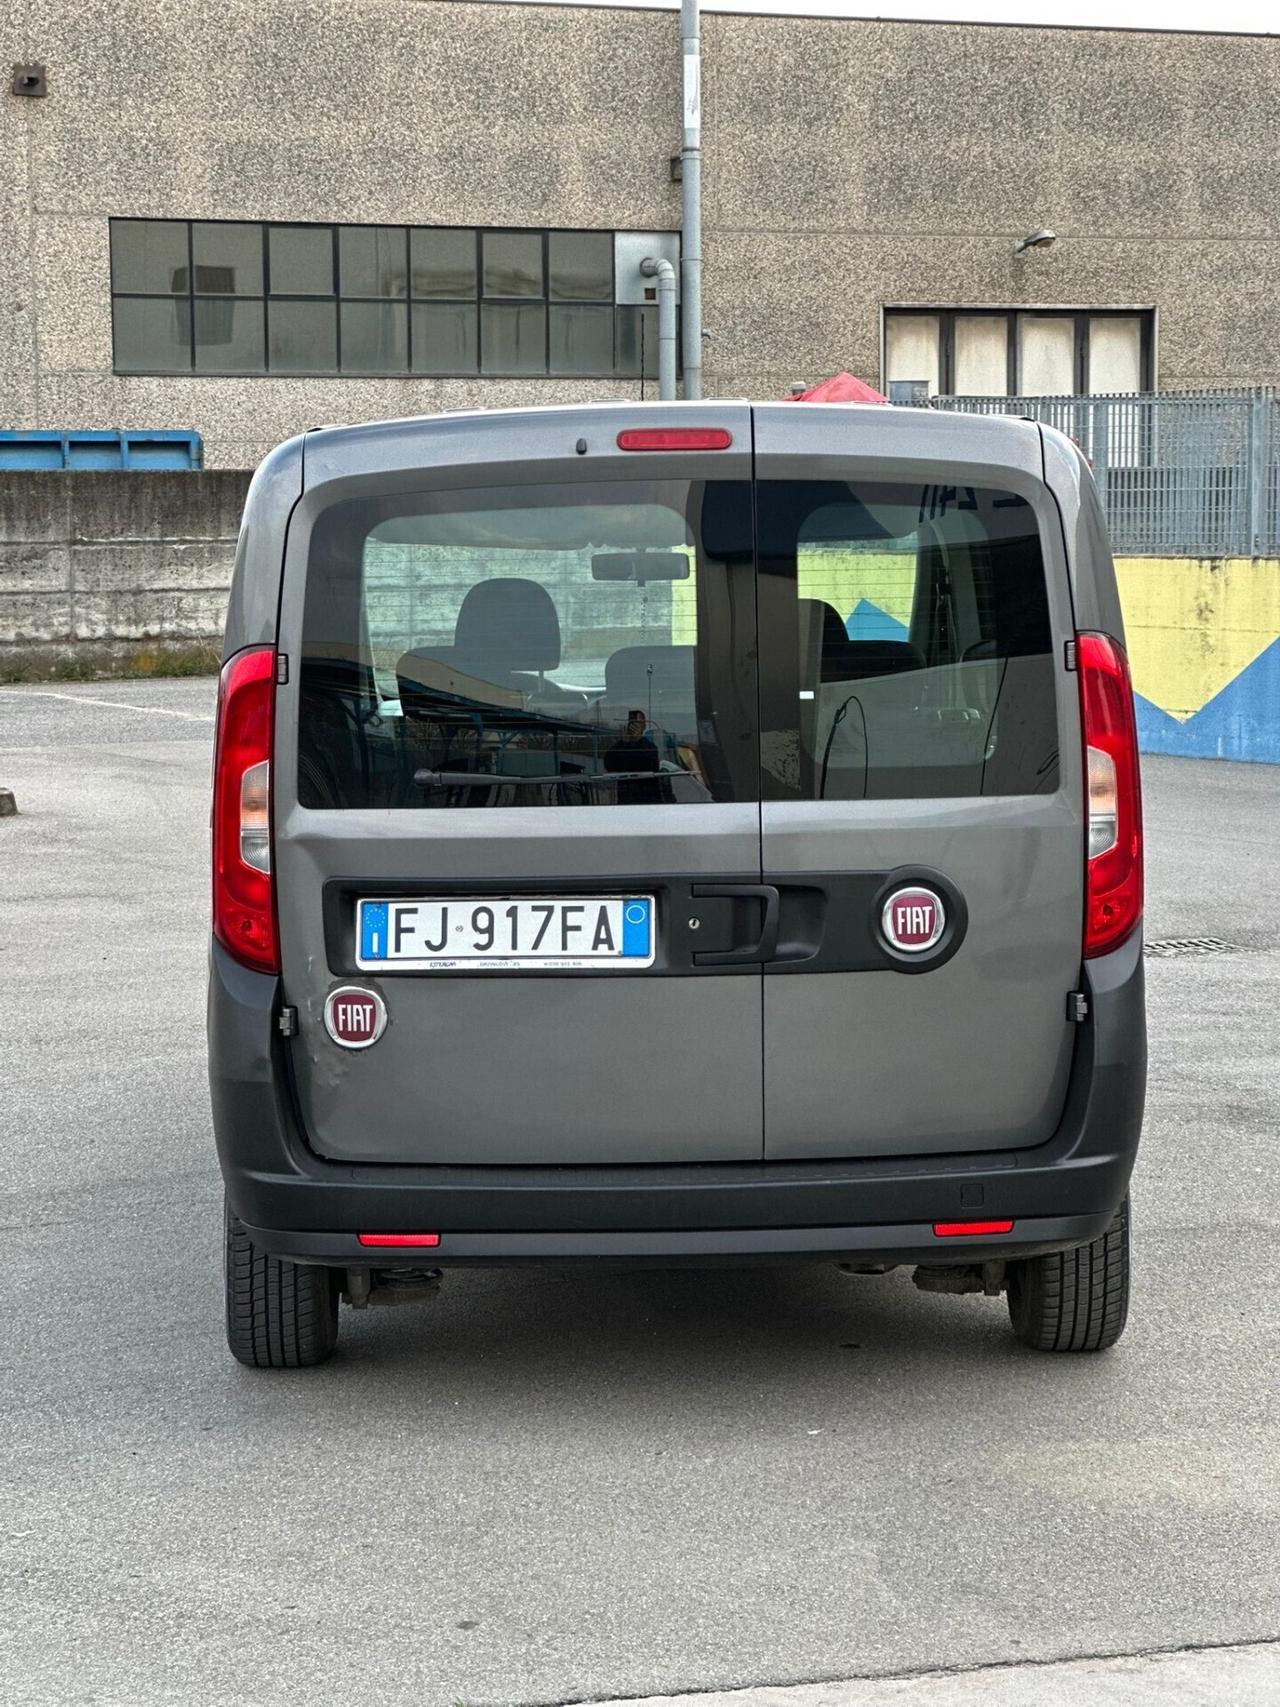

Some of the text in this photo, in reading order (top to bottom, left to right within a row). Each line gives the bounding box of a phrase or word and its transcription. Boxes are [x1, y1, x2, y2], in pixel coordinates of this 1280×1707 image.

[394, 904, 615, 953] FJ 917FA
[897, 906, 933, 935] FIAT
[372, 932, 379, 953] I
[338, 1004, 374, 1032] FIAT
